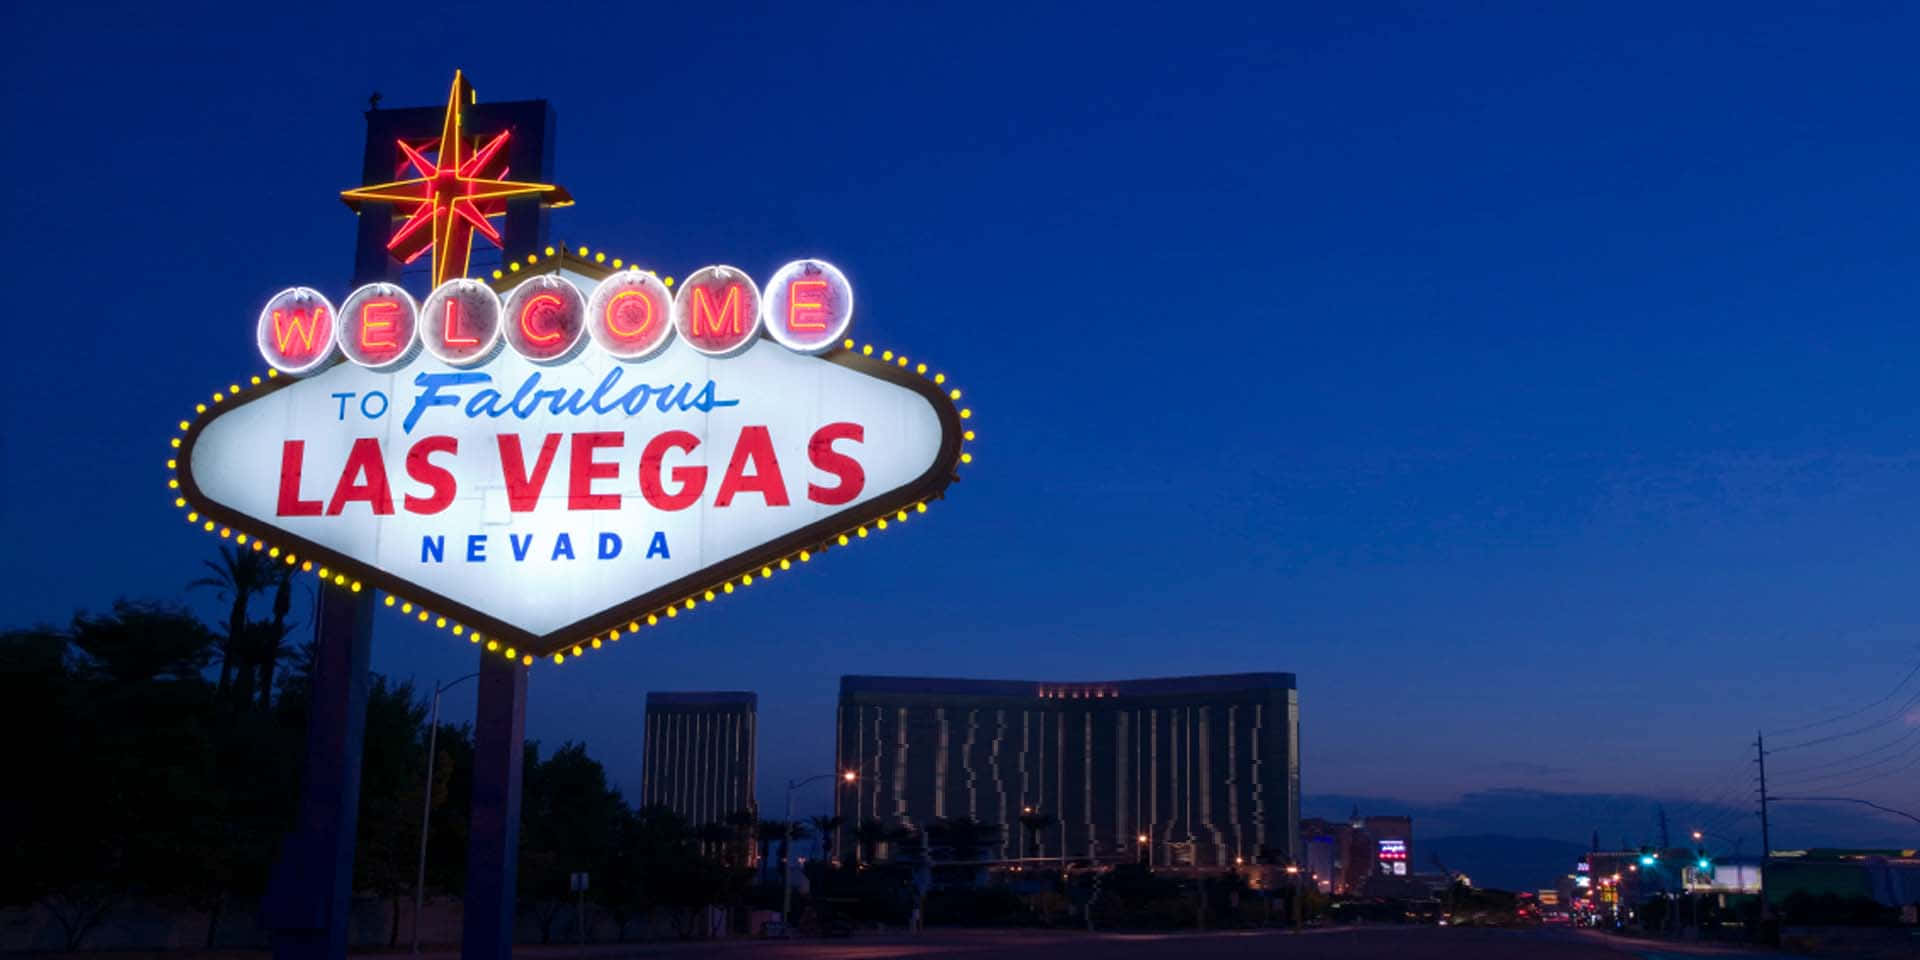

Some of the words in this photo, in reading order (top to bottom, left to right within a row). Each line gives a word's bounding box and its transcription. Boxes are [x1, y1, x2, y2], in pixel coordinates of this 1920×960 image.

[271, 279, 829, 353] WELCOME
[332, 391, 388, 421] TO
[403, 366, 740, 434] Fabulous
[276, 434, 459, 518] LAS
[496, 421, 866, 513] VEGAS
[421, 531, 672, 563] NEVADA
